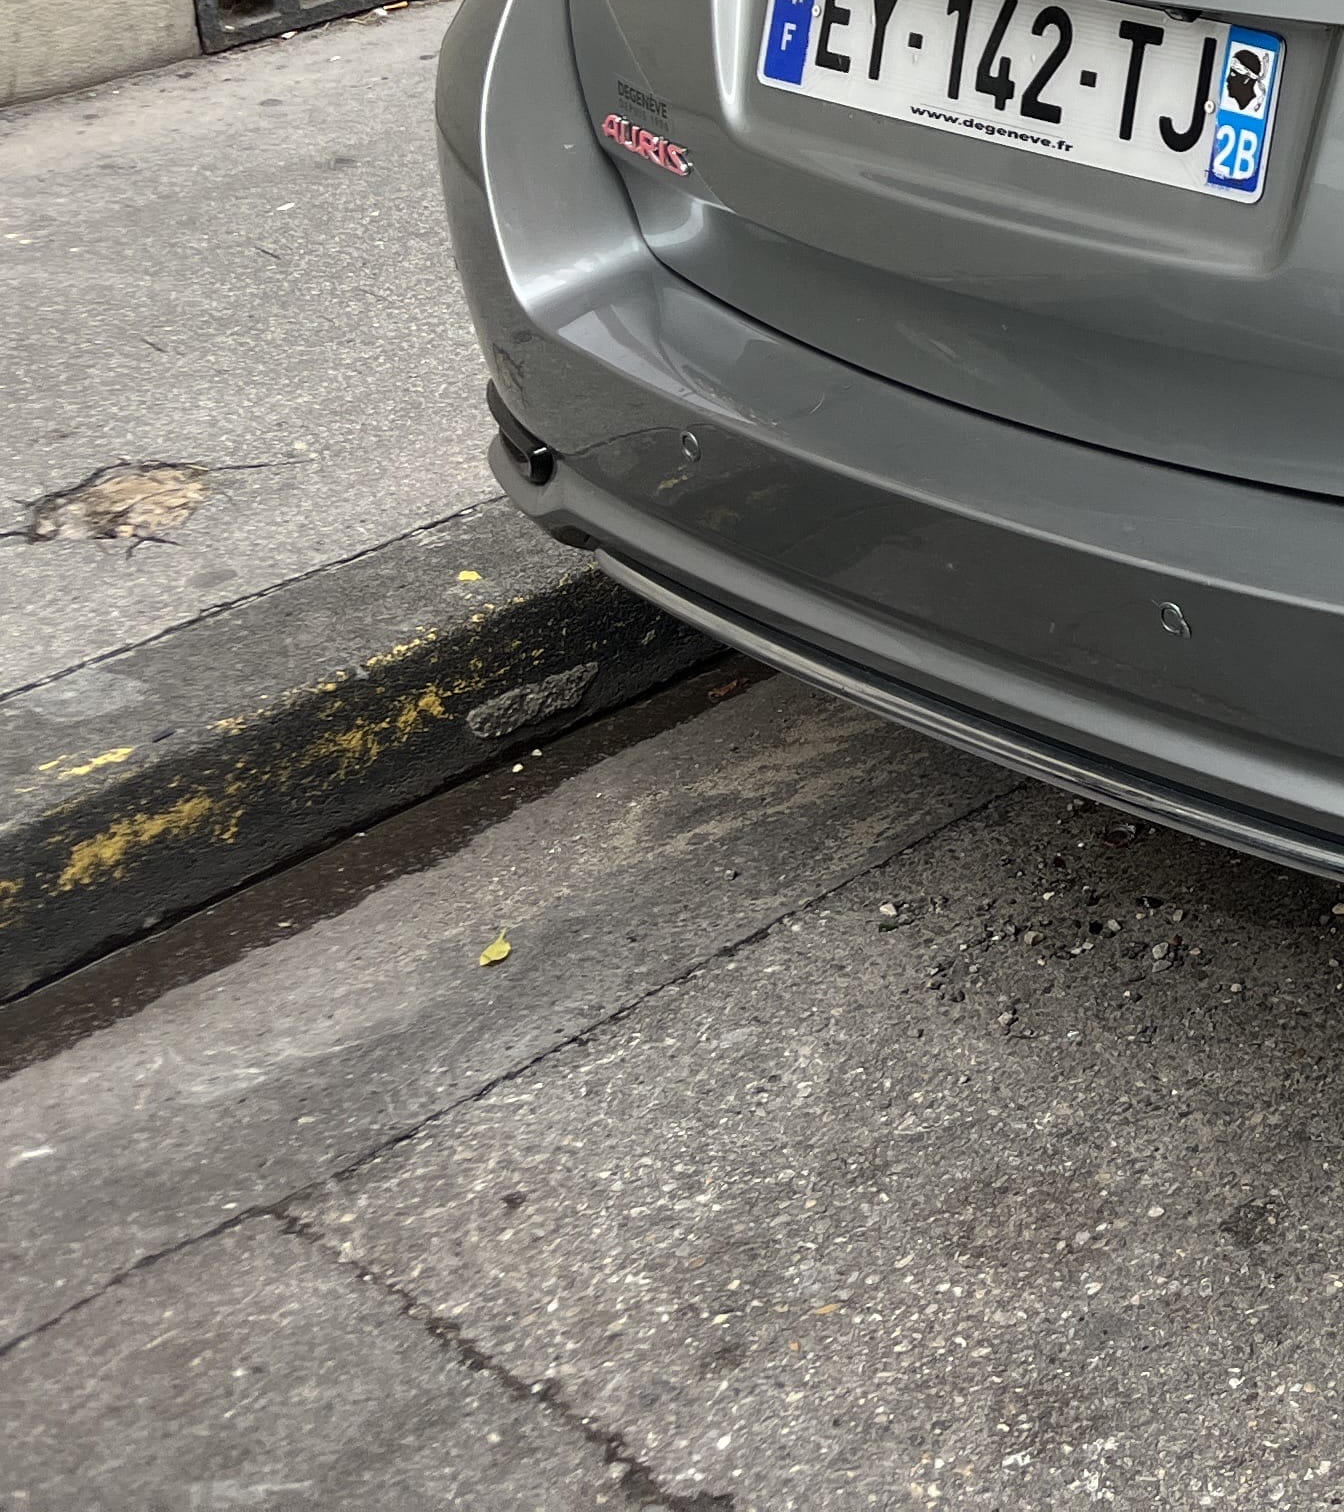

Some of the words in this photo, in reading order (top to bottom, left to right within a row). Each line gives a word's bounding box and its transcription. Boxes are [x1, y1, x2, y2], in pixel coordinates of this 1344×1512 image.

[780, 21, 799, 52] F
[601, 113, 694, 177] AURIS
[909, 105, 1075, 153] www.degeneve.fr
[1213, 124, 1259, 182] 2B
